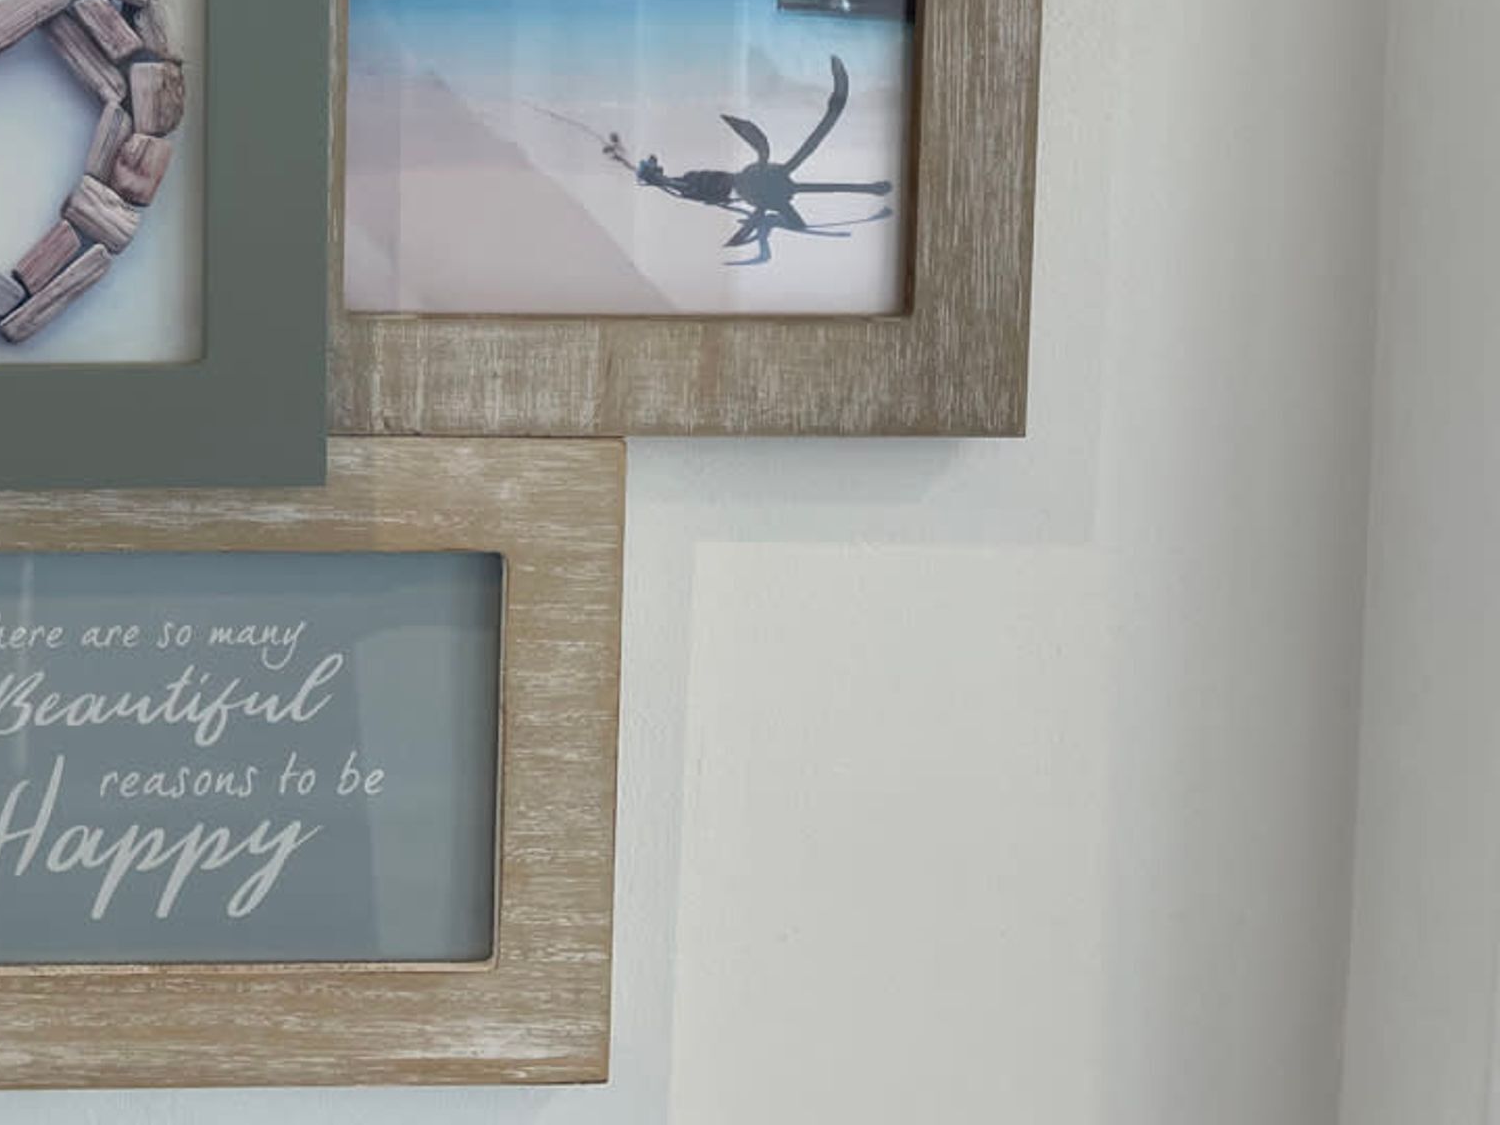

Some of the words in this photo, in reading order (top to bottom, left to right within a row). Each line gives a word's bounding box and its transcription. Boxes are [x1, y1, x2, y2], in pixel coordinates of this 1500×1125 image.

[80, 624, 141, 648] are
[156, 620, 192, 649] so
[208, 619, 307, 671] many
[99, 765, 259, 799] reasons
[278, 751, 316, 797] to
[336, 750, 385, 797] be
